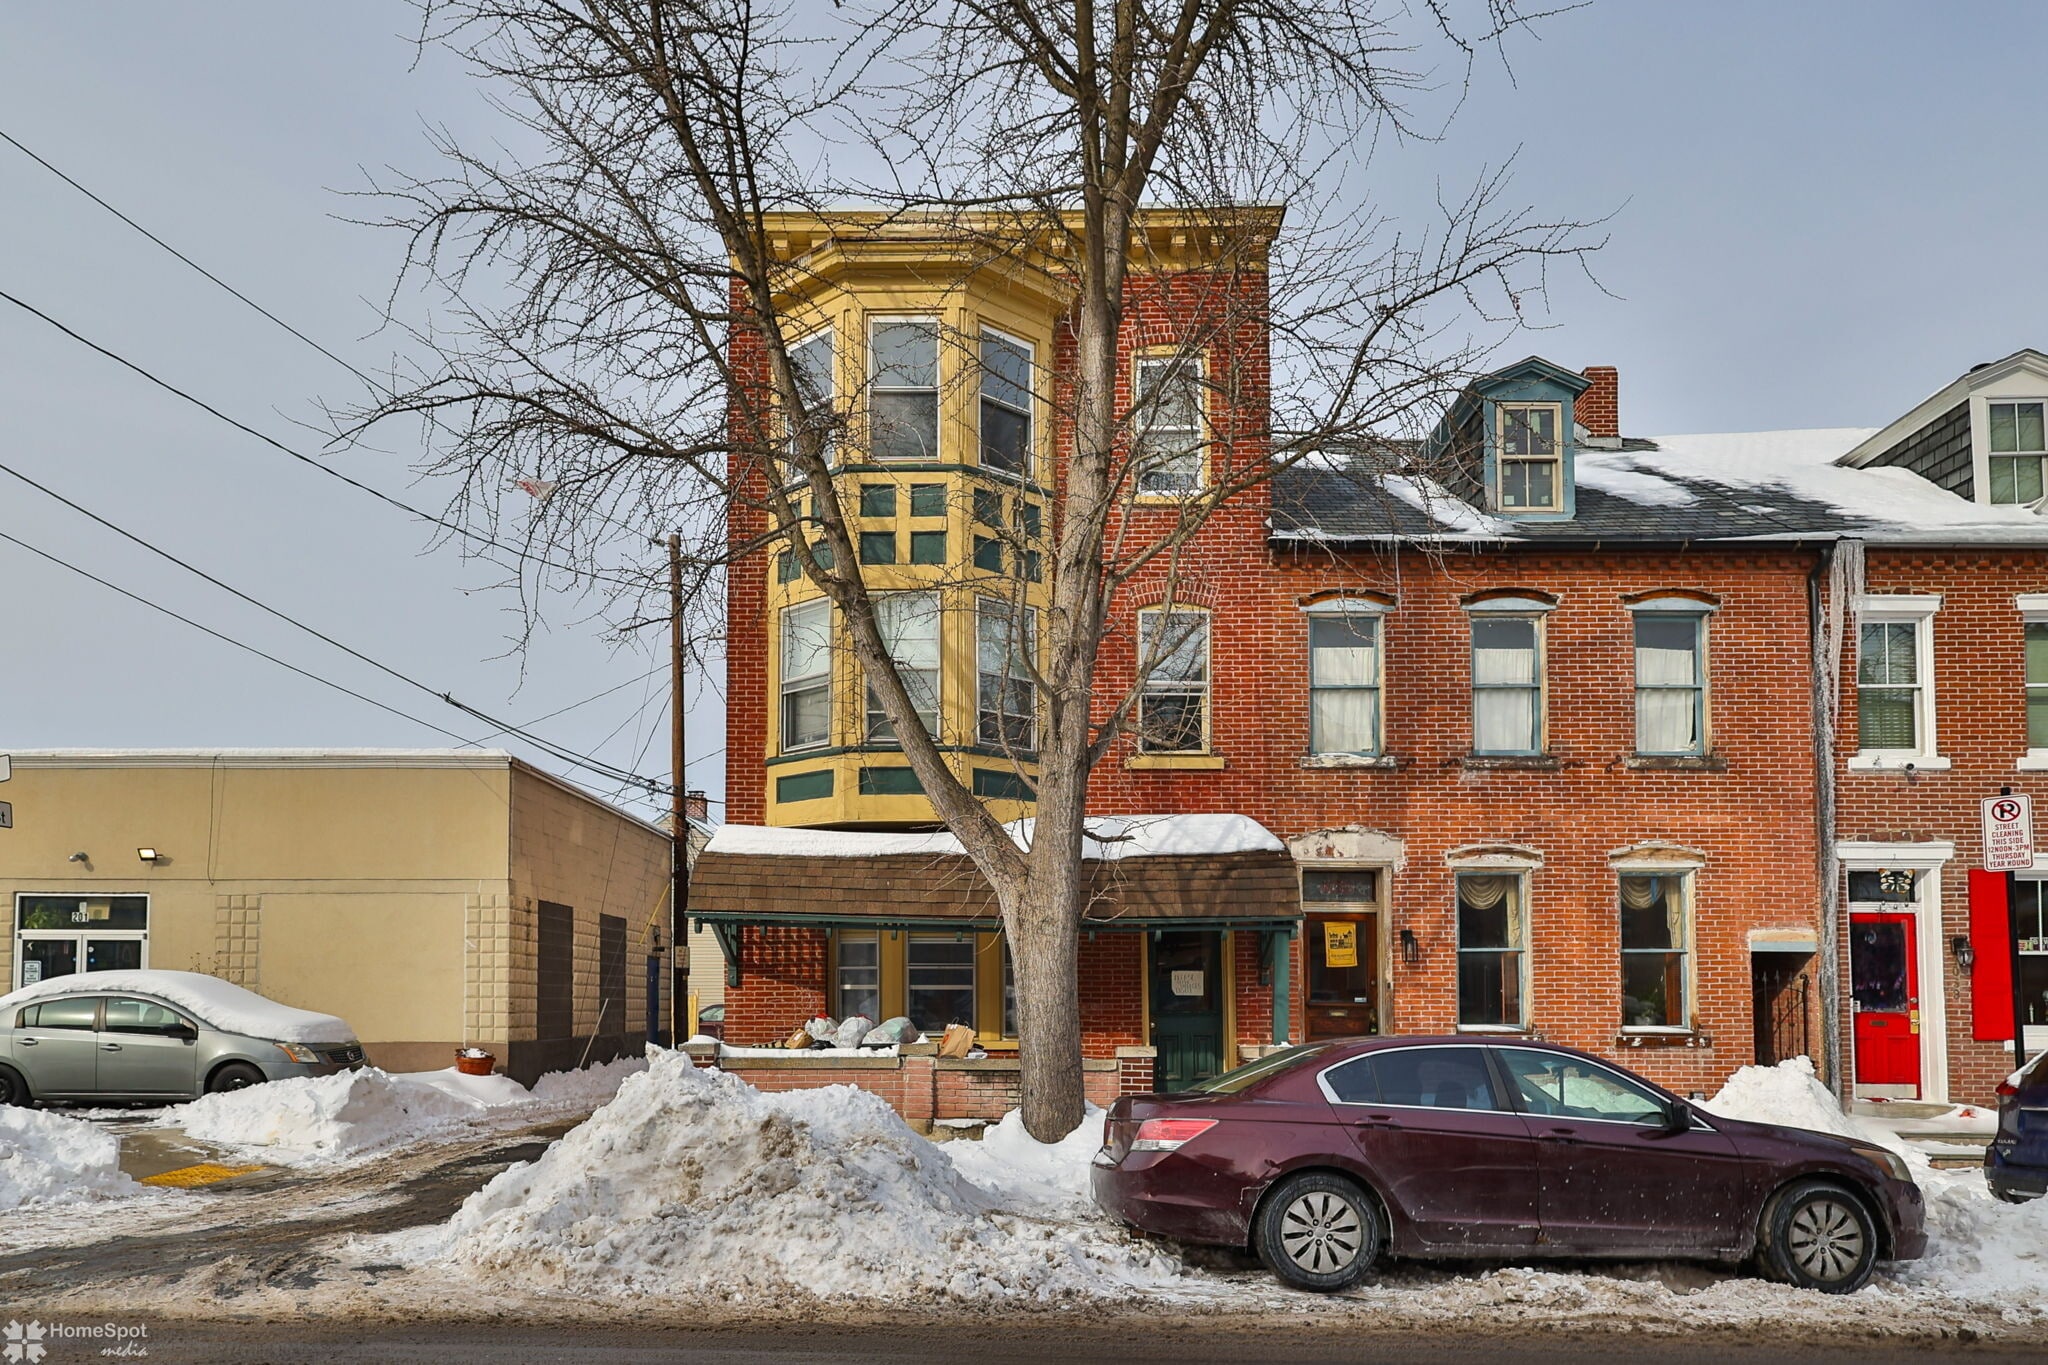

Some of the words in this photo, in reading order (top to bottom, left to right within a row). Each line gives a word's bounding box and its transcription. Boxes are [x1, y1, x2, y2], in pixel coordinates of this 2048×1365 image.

[1995, 823, 2019, 831] STREET
[1991, 830, 2024, 838] CLEANING
[1992, 852, 2025, 860] THURSDAY
[73, 912, 88, 922] 201
